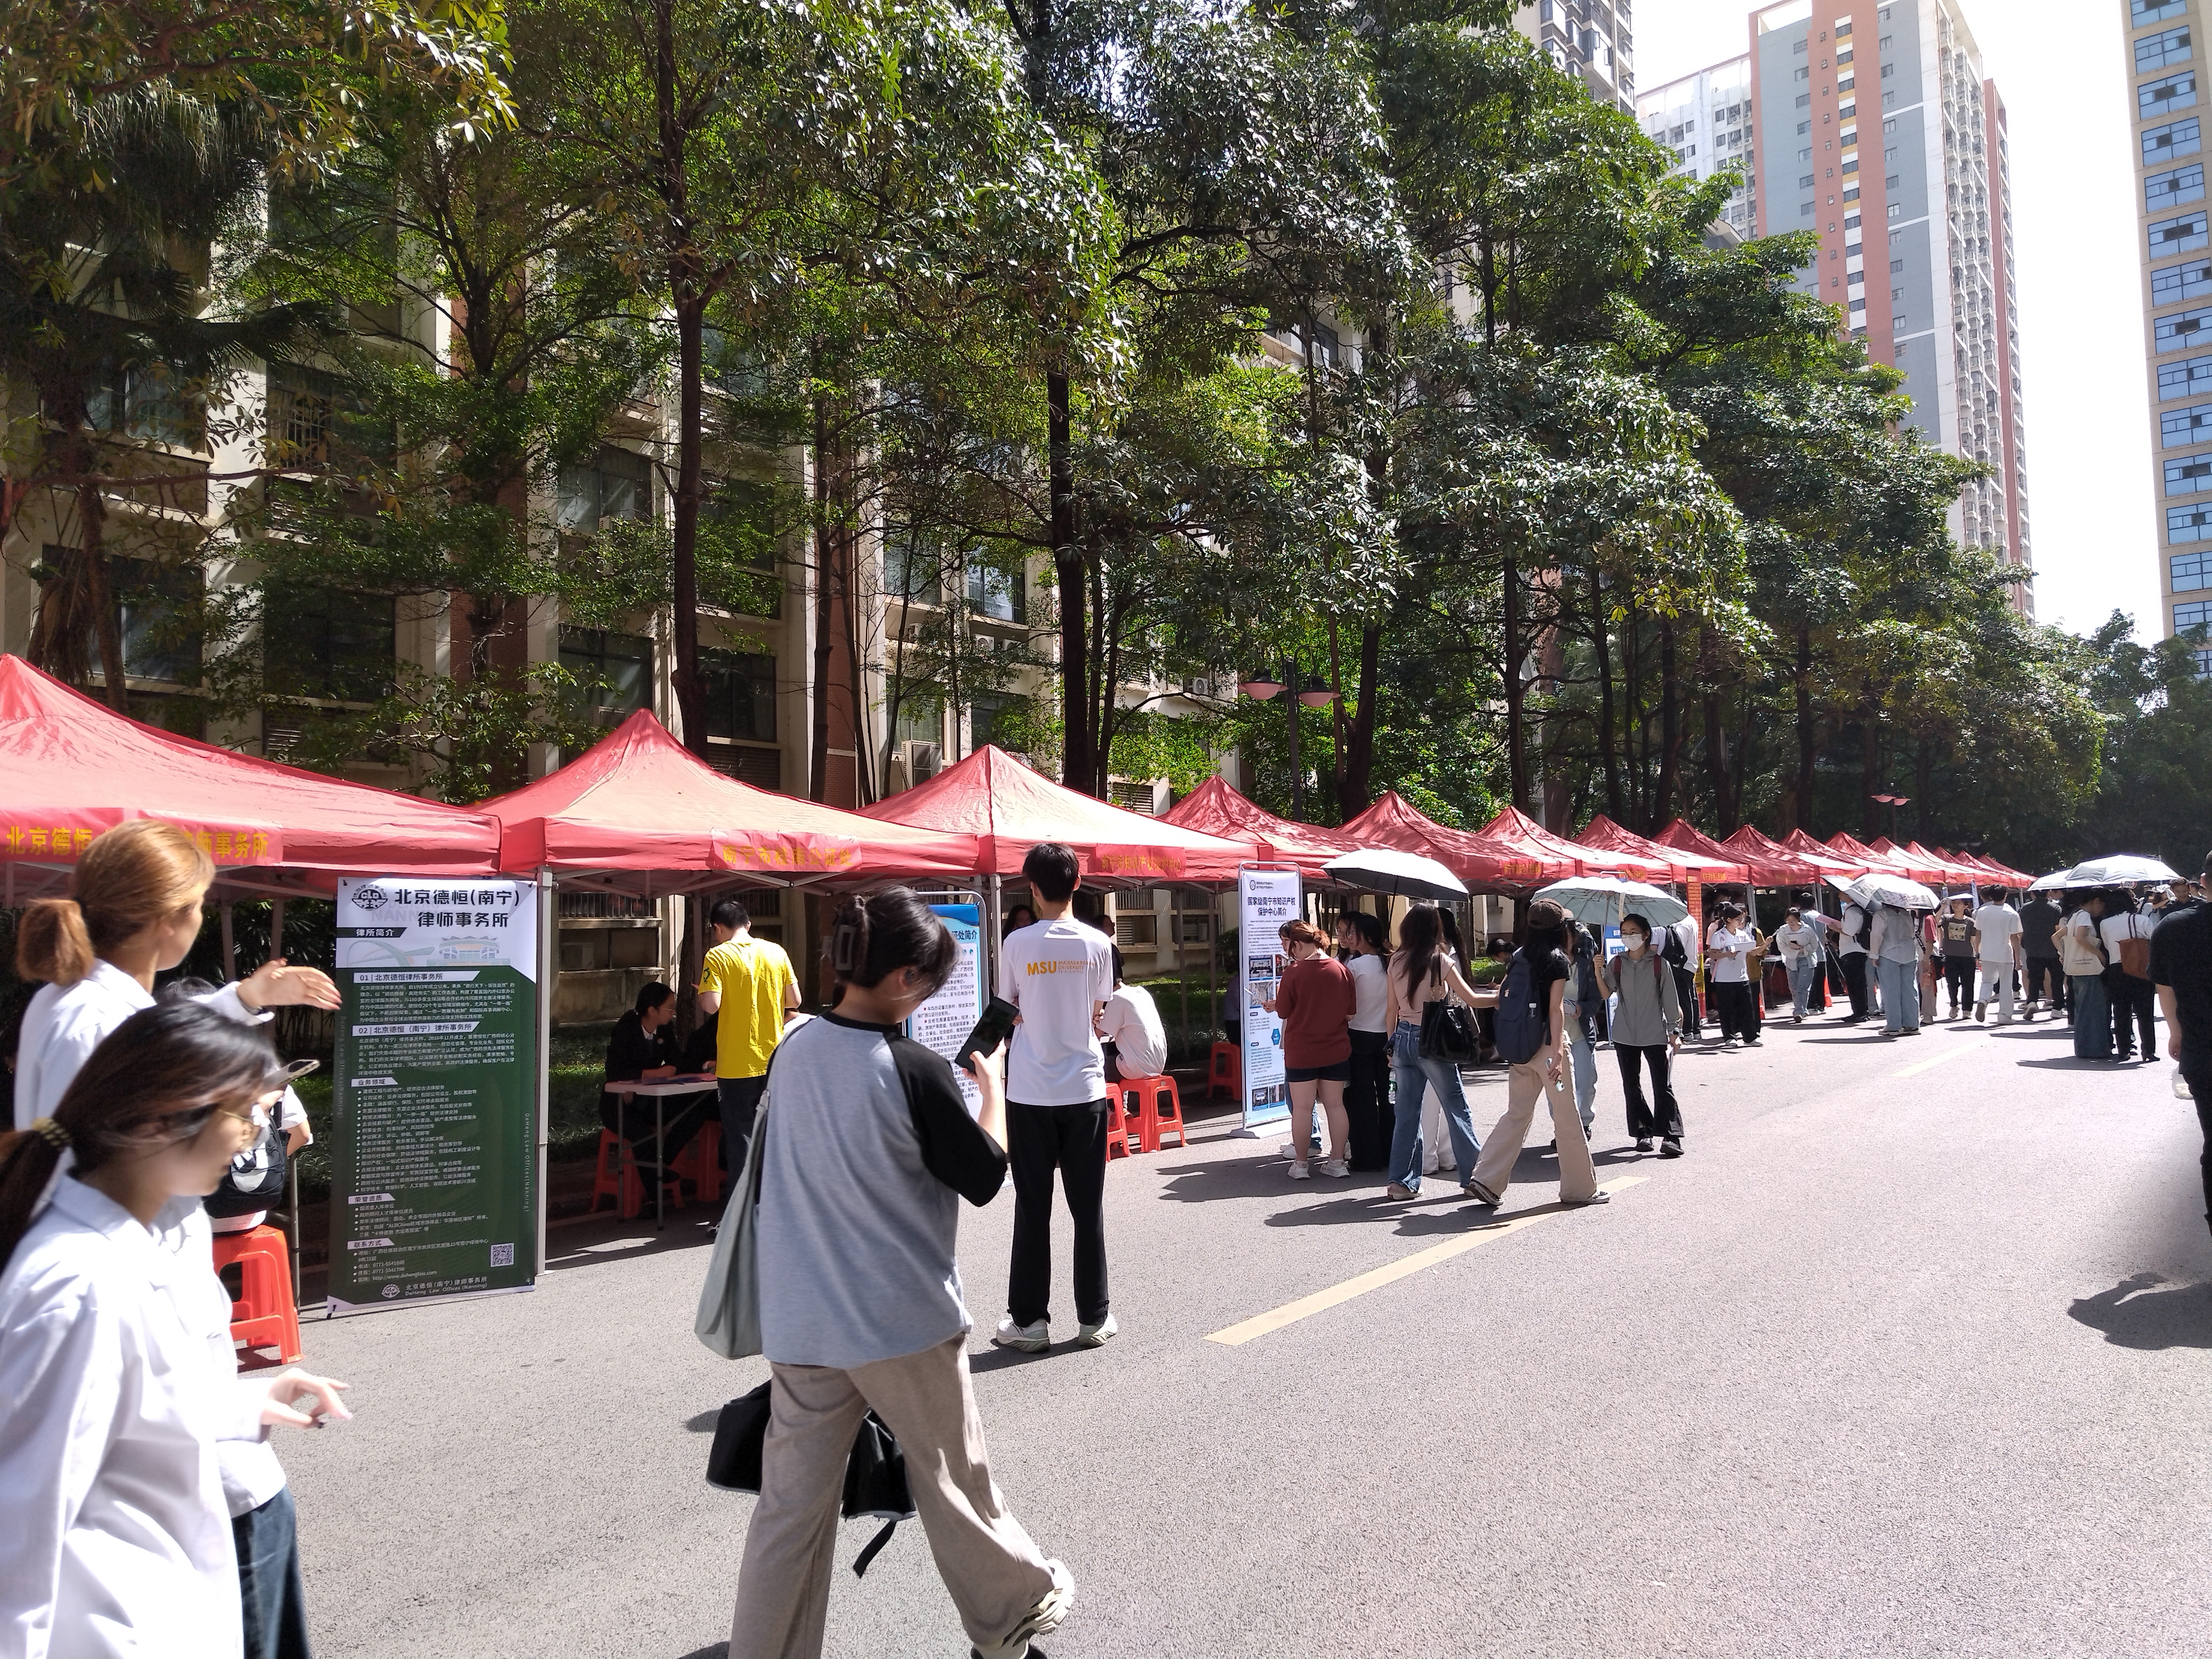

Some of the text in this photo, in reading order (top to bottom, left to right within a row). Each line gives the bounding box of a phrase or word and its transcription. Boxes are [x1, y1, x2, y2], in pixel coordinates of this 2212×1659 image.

[184, 831, 269, 859] 师事务所
[1248, 896, 1296, 906] 国家级南宁市知识产权
[1258, 907, 1287, 916] 保护中心简介
[418, 912, 508, 927] 律师事务所
[356, 928, 394, 937] 律所简介
[1027, 961, 1057, 976] MSU
[354, 1194, 382, 1203] 荣誉资质
